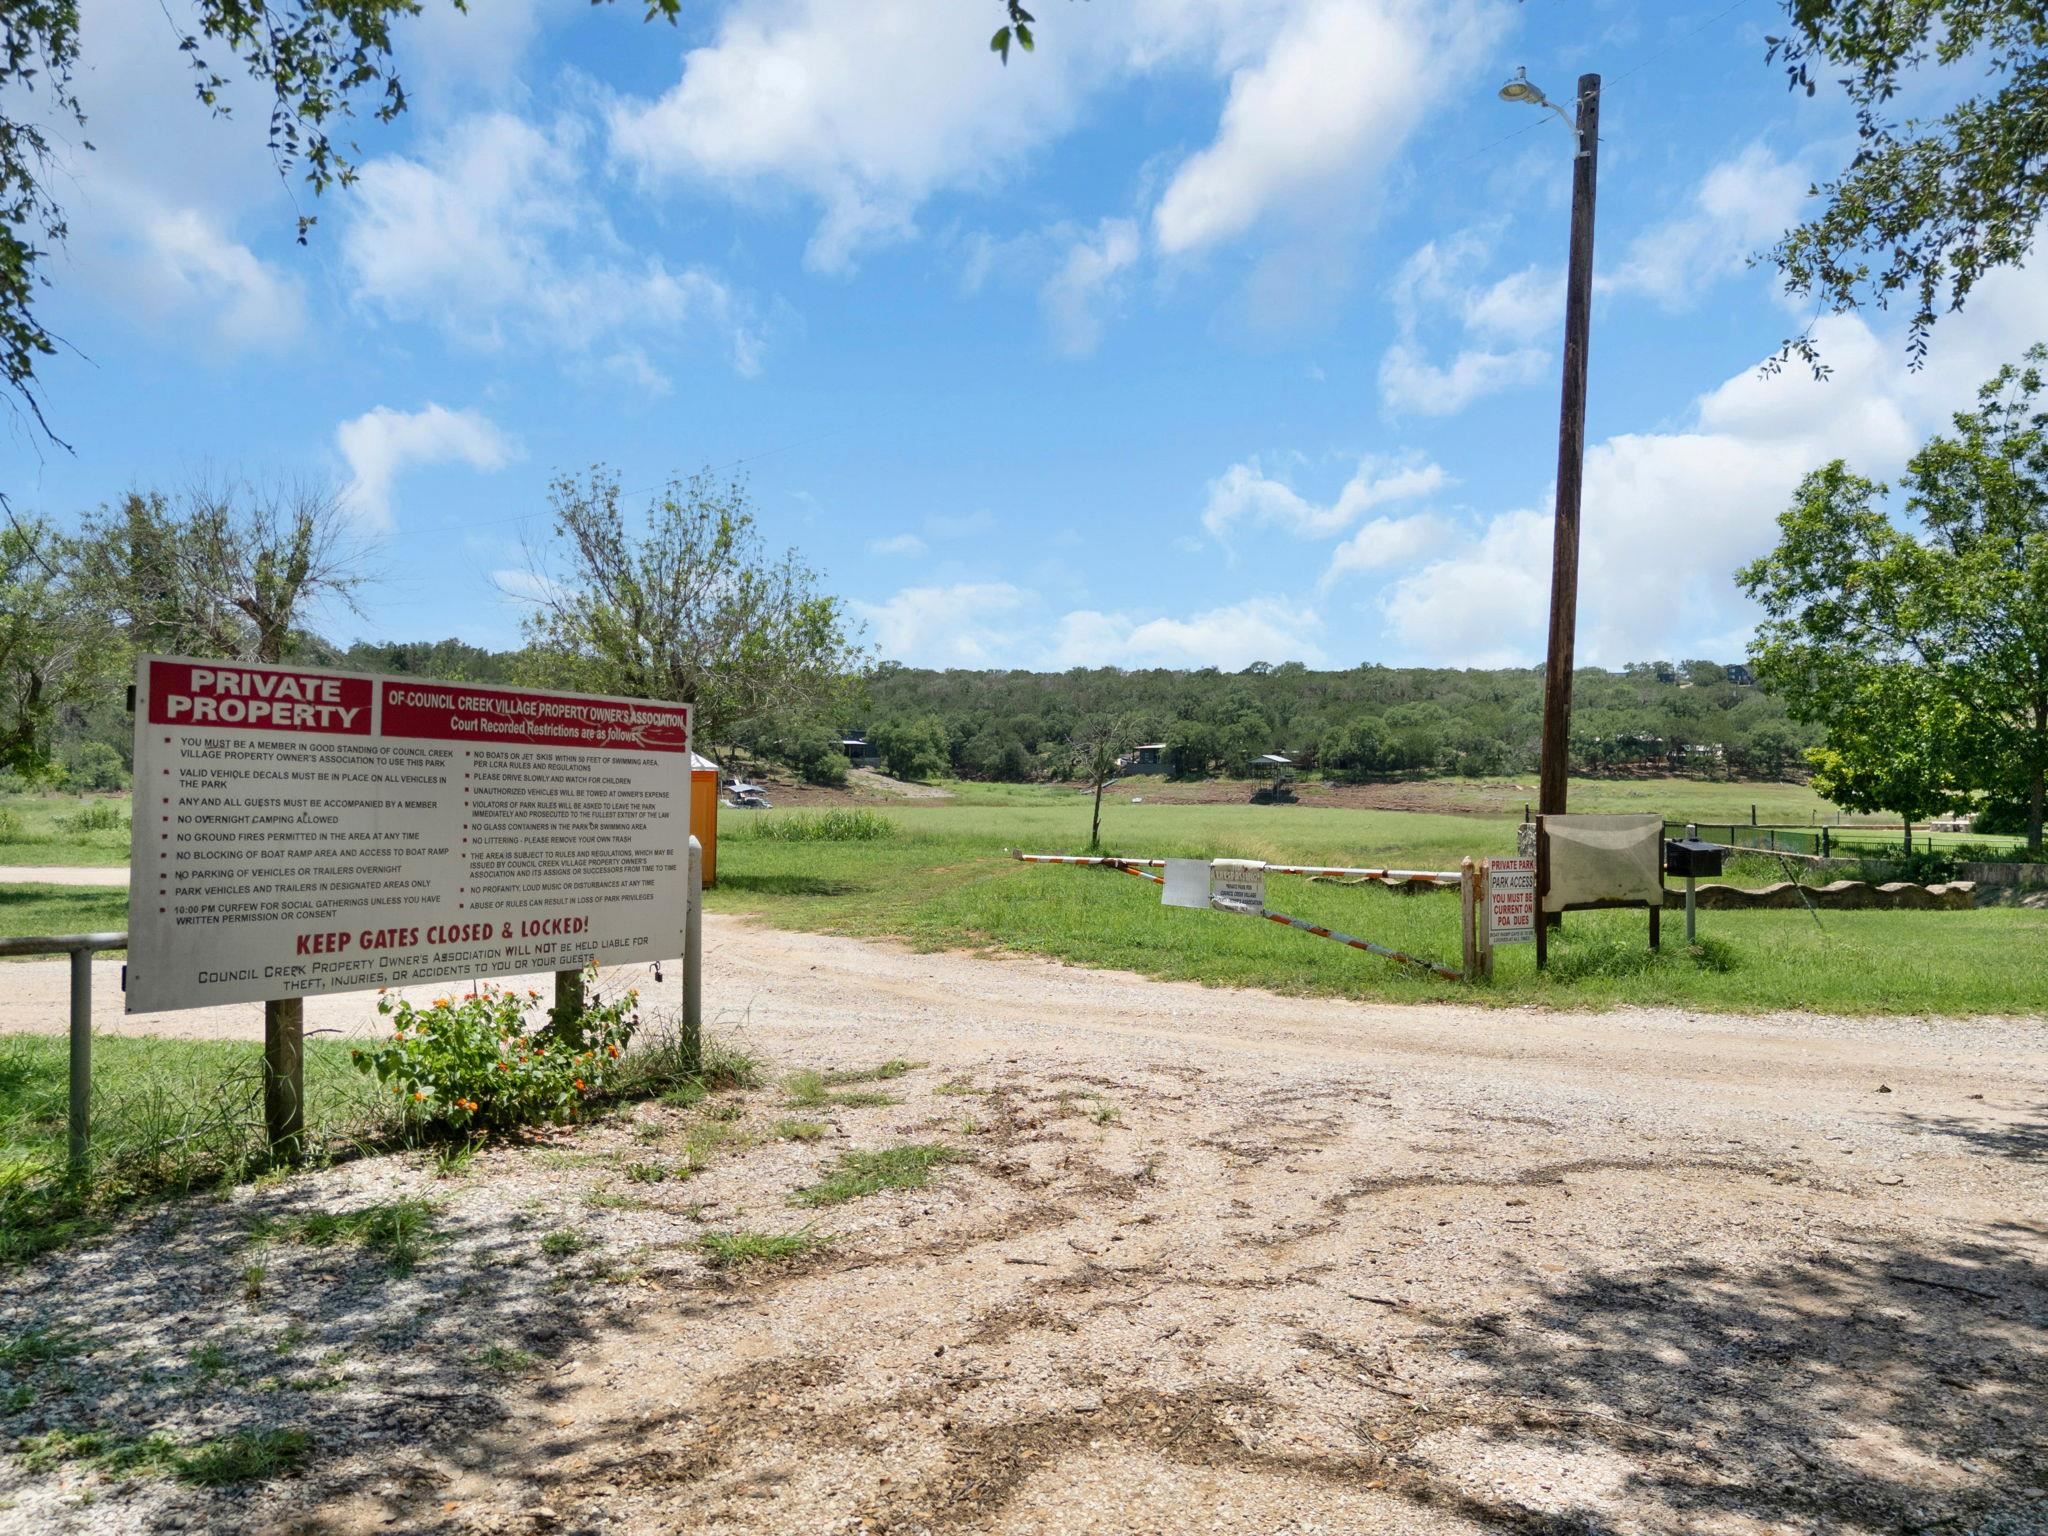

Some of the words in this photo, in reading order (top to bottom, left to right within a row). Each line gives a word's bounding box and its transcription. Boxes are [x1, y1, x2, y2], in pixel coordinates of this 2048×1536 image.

[190, 669, 342, 702] PRIVATE
[167, 694, 361, 729] PROPERTY
[389, 690, 405, 705] OF
[407, 692, 455, 709] COUNCIL
[458, 696, 494, 712] CREEK
[496, 700, 537, 716] VILLAGE
[539, 702, 587, 719] PROPERTY
[590, 707, 629, 723] OWNER'S
[630, 710, 684, 727] ASSOCIATION
[451, 716, 478, 731] Court
[480, 718, 525, 734] Recorded
[527, 721, 580, 738] Restrictions
[581, 728, 594, 738] are
[596, 730, 606, 740] as
[181, 738, 202, 746] YOU
[205, 739, 230, 748] MUST
[258, 742, 296, 750] MEMBER
[337, 745, 378, 754] STANDING
[393, 748, 426, 756] COUNCIL
[181, 750, 221, 758] VILLAGE
[225, 752, 273, 760] PROPERTY
[276, 753, 316, 762] OWNER'S
[320, 755, 374, 764] ASSOCIATION
[181, 769, 208, 777] VALID
[211, 770, 250, 779] VEHICLE
[253, 771, 289, 779] DECALS
[292, 772, 315, 780] MUST
[202, 780, 226, 788] PARK
[175, 871, 188, 879] NO
[192, 870, 233, 878] PARKING
[252, 868, 295, 876] VEHICLES
[314, 867, 354, 875] TRAILERS
[356, 865, 402, 874] OVERNIGHT
[1492, 861, 1517, 870] PRIVATE
[1519, 860, 1534, 869] PARK
[205, 886, 250, 895] VEHICLES
[275, 884, 317, 892] TRAILERS
[330, 882, 380, 890] DESIGNATED
[574, 881, 619, 889] DISTURBANCES
[1492, 877, 1508, 888] PARK
[1510, 876, 1533, 887] ACCESS
[1493, 894, 1505, 903] YOU
[1507, 894, 1523, 902] MUST
[1525, 893, 1532, 902] BE
[1494, 905, 1522, 914] CURRENT
[1525, 904, 1532, 913] ON
[176, 916, 219, 925] WRITTEN
[222, 913, 278, 923] PERMISSION
[296, 910, 337, 919] CONSENT
[1498, 917, 1510, 926] POA
[1514, 916, 1529, 925] DUES
[296, 932, 352, 955] KEEP
[360, 927, 419, 950] GATES
[427, 923, 493, 945] CLOSED
[502, 922, 513, 939] &
[521, 916, 589, 938] LOCKED!
[283, 978, 326, 991] THEFT,
[331, 972, 388, 986] INJURIES,
[392, 970, 407, 980] OR
[412, 966, 470, 978] ACCIDENTS
[475, 964, 488, 976] TO
[492, 961, 510, 974] YOU
[515, 959, 527, 968] OR
[532, 957, 556, 970] YOUR
[560, 954, 595, 966] GUESTS
